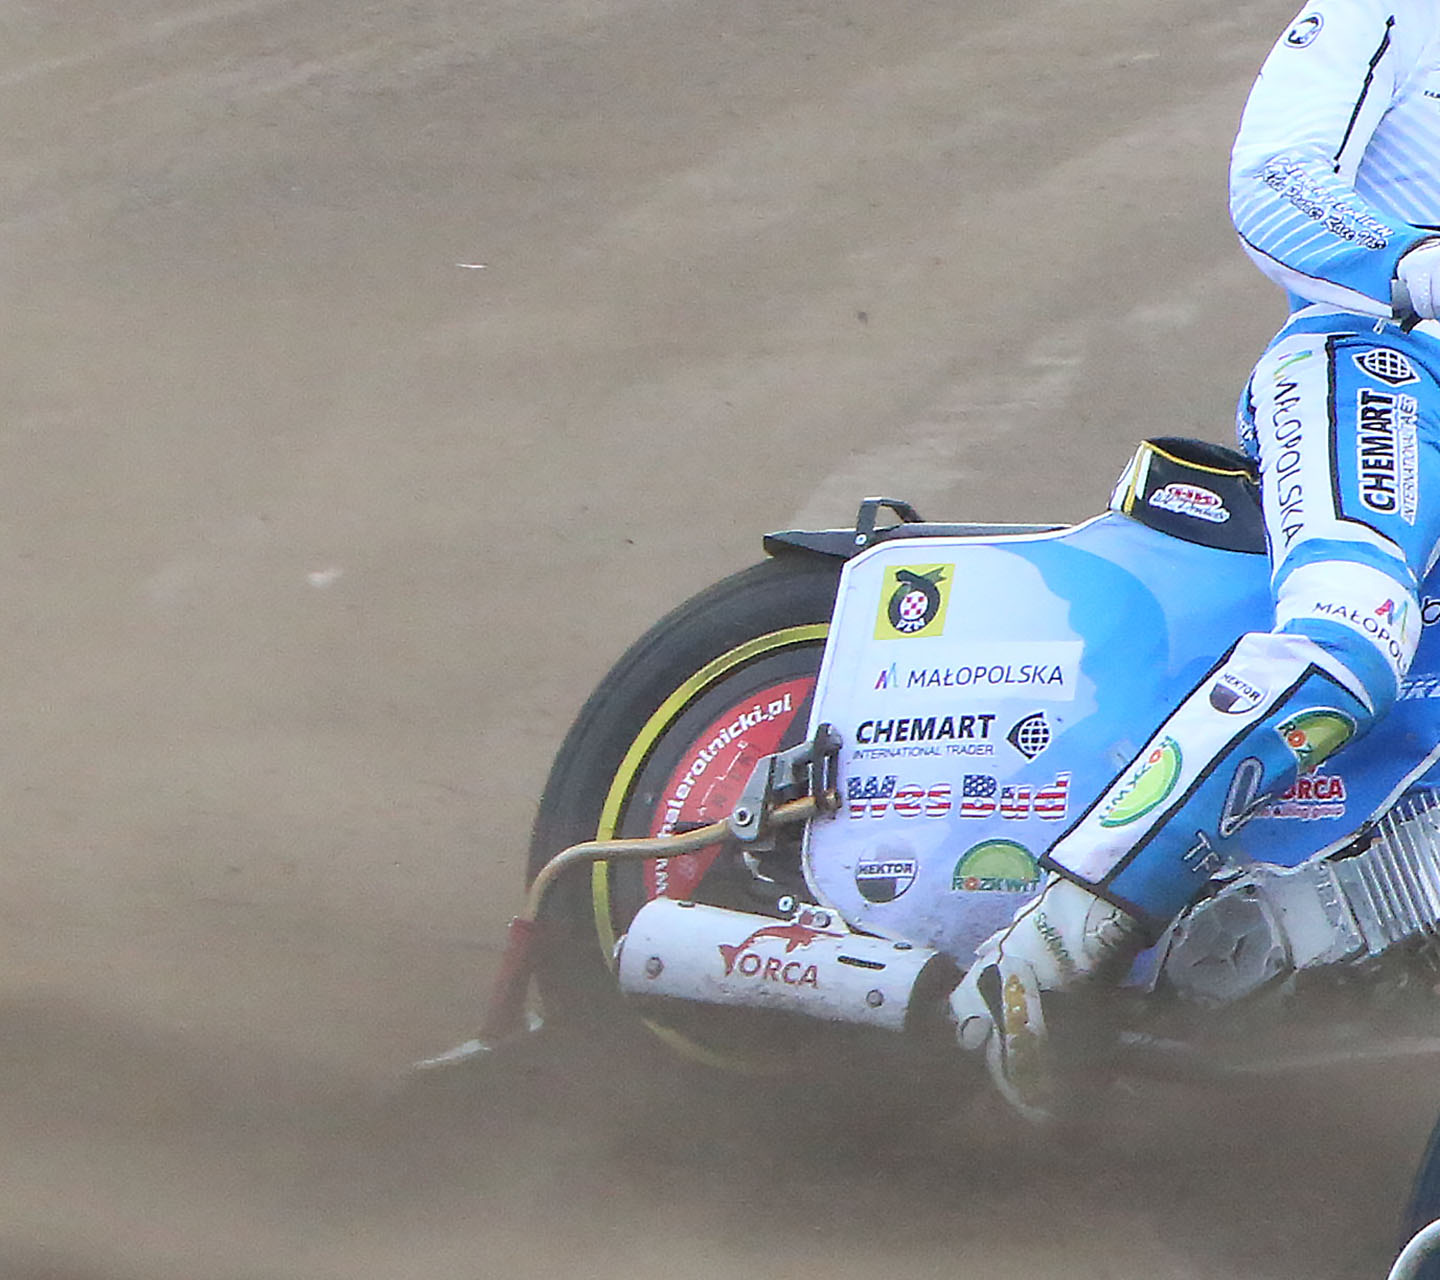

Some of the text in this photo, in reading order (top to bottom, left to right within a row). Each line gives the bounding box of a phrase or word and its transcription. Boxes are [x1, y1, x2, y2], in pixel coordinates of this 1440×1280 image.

[1360, 390, 1396, 513] CHEMART
[907, 664, 1064, 690] MAŁOPOLSKA
[855, 714, 997, 745] CHEMART
[946, 743, 994, 757] TRADER
[846, 770, 1072, 820] Wes Bud
